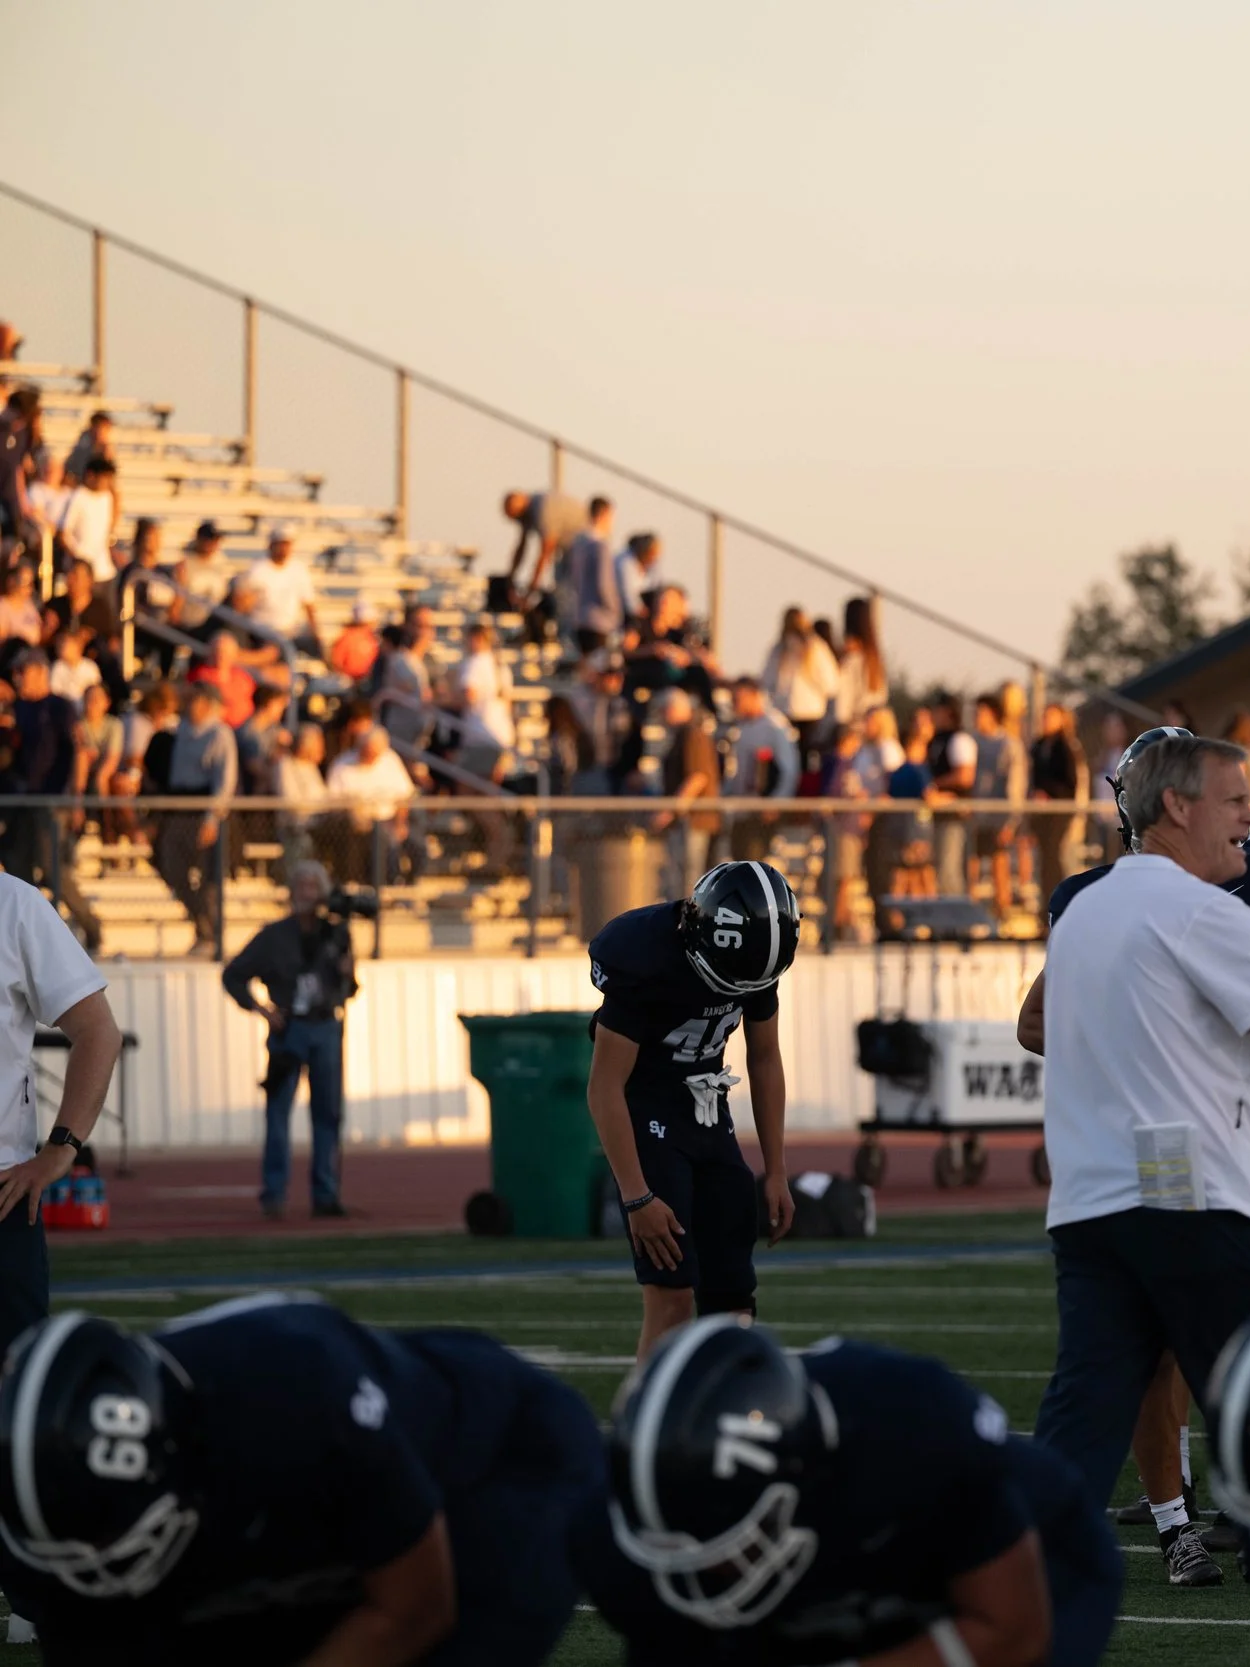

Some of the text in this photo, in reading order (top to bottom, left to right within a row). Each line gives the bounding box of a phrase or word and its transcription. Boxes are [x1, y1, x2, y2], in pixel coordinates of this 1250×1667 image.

[713, 906, 744, 949] 46
[702, 1002, 734, 1017] RANGERS
[649, 1120, 666, 1138] SV
